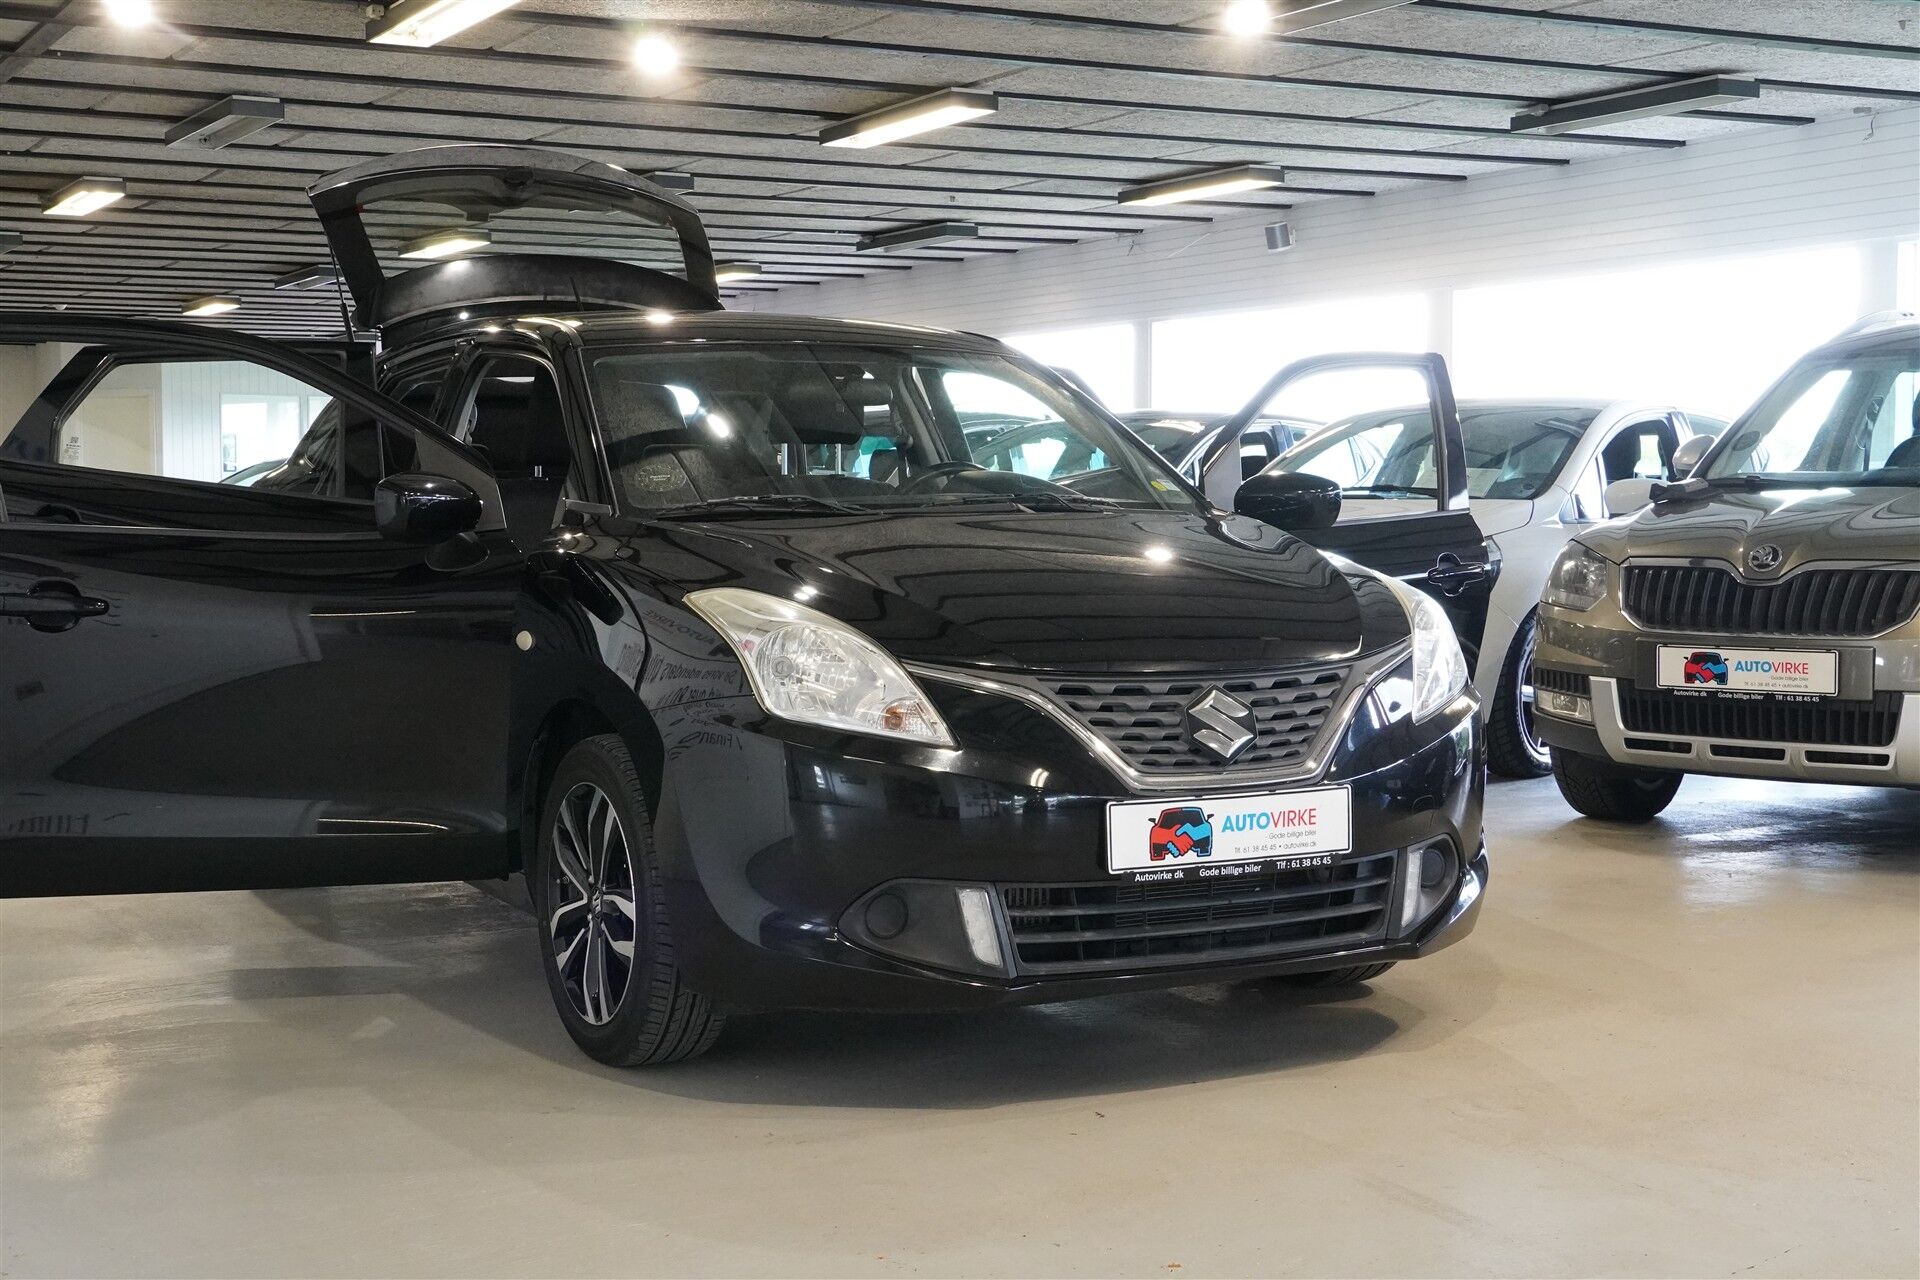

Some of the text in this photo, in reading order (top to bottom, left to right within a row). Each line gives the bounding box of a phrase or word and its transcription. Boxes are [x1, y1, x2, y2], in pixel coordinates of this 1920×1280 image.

[1734, 660, 1809, 675] AUTOVIRKE
[1673, 689, 1699, 697] Autovirke
[1717, 691, 1733, 699] Gode
[1733, 692, 1751, 700] billige
[1221, 807, 1317, 833] AUTOVIRKE
[1268, 832, 1286, 840] Gode
[1286, 830, 1304, 839] billige
[1260, 844, 1269, 852] 45
[1269, 843, 1278, 851] 45
[1134, 871, 1173, 882] Autovirke
[1174, 870, 1184, 879] dk
[1199, 867, 1219, 877] Gode
[1220, 865, 1244, 876] billige
[1244, 864, 1262, 873] biler
[1276, 860, 1286, 869] Tlf
[1291, 859, 1300, 868] 61
[1301, 858, 1311, 867] 38
[1311, 857, 1321, 866] 45
[1322, 856, 1331, 865] 45
